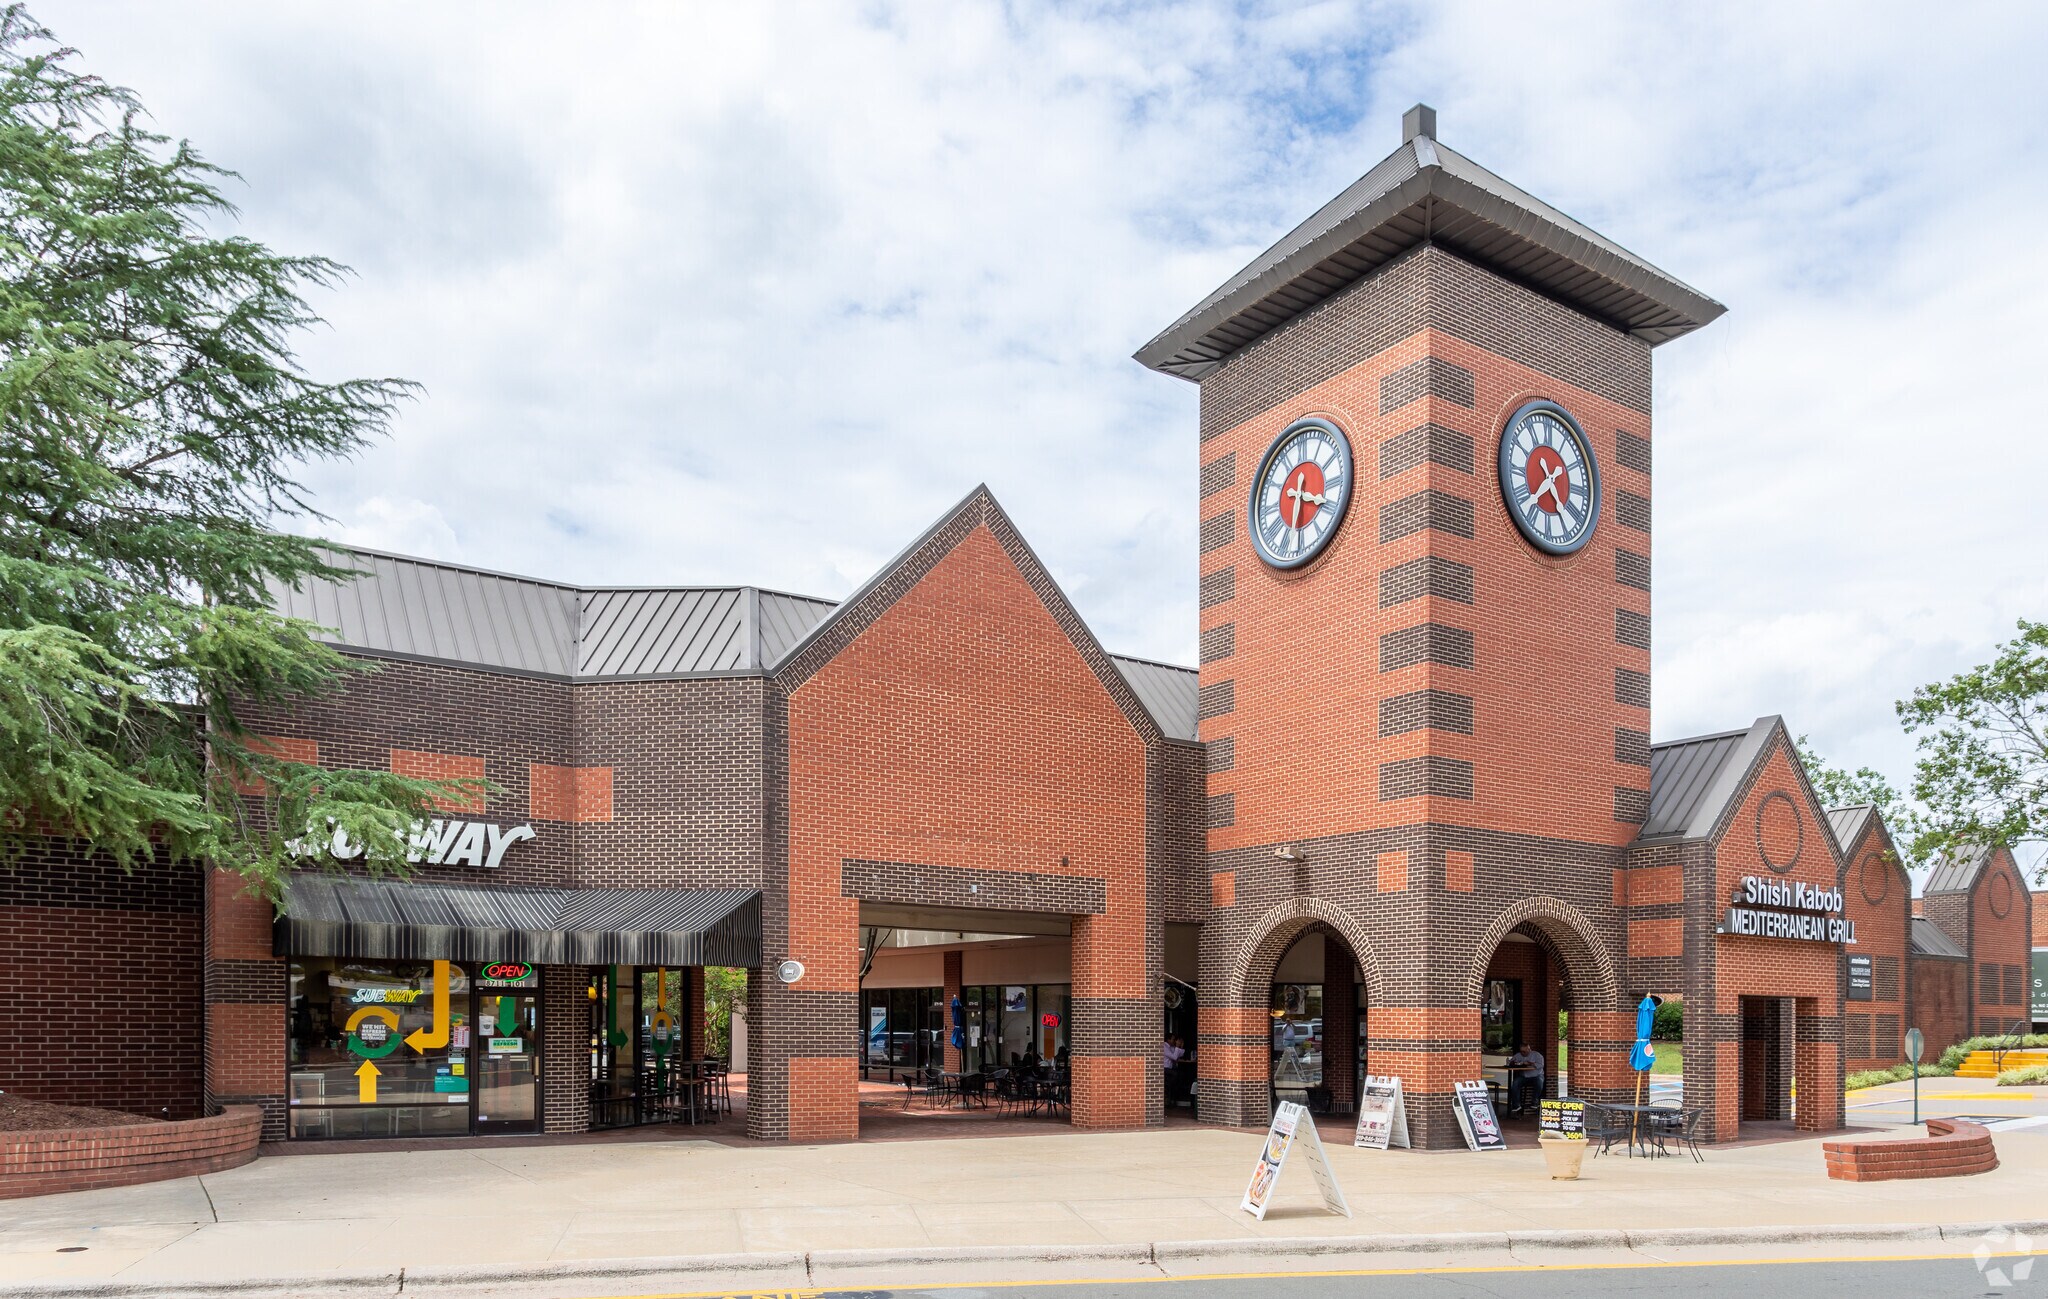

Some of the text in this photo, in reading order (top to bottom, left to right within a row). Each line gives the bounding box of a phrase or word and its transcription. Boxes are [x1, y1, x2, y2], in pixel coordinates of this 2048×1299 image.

[1745, 876, 1843, 913] Shish Kabob
[1731, 908, 1857, 945] MEDITERRANEAN GRILL
[488, 965, 525, 977] OPEN
[351, 988, 424, 1003] SUBWAY
[1042, 1014, 1059, 1028] OPEN
[1541, 1101, 1584, 1110] WE'RE OPEN!
